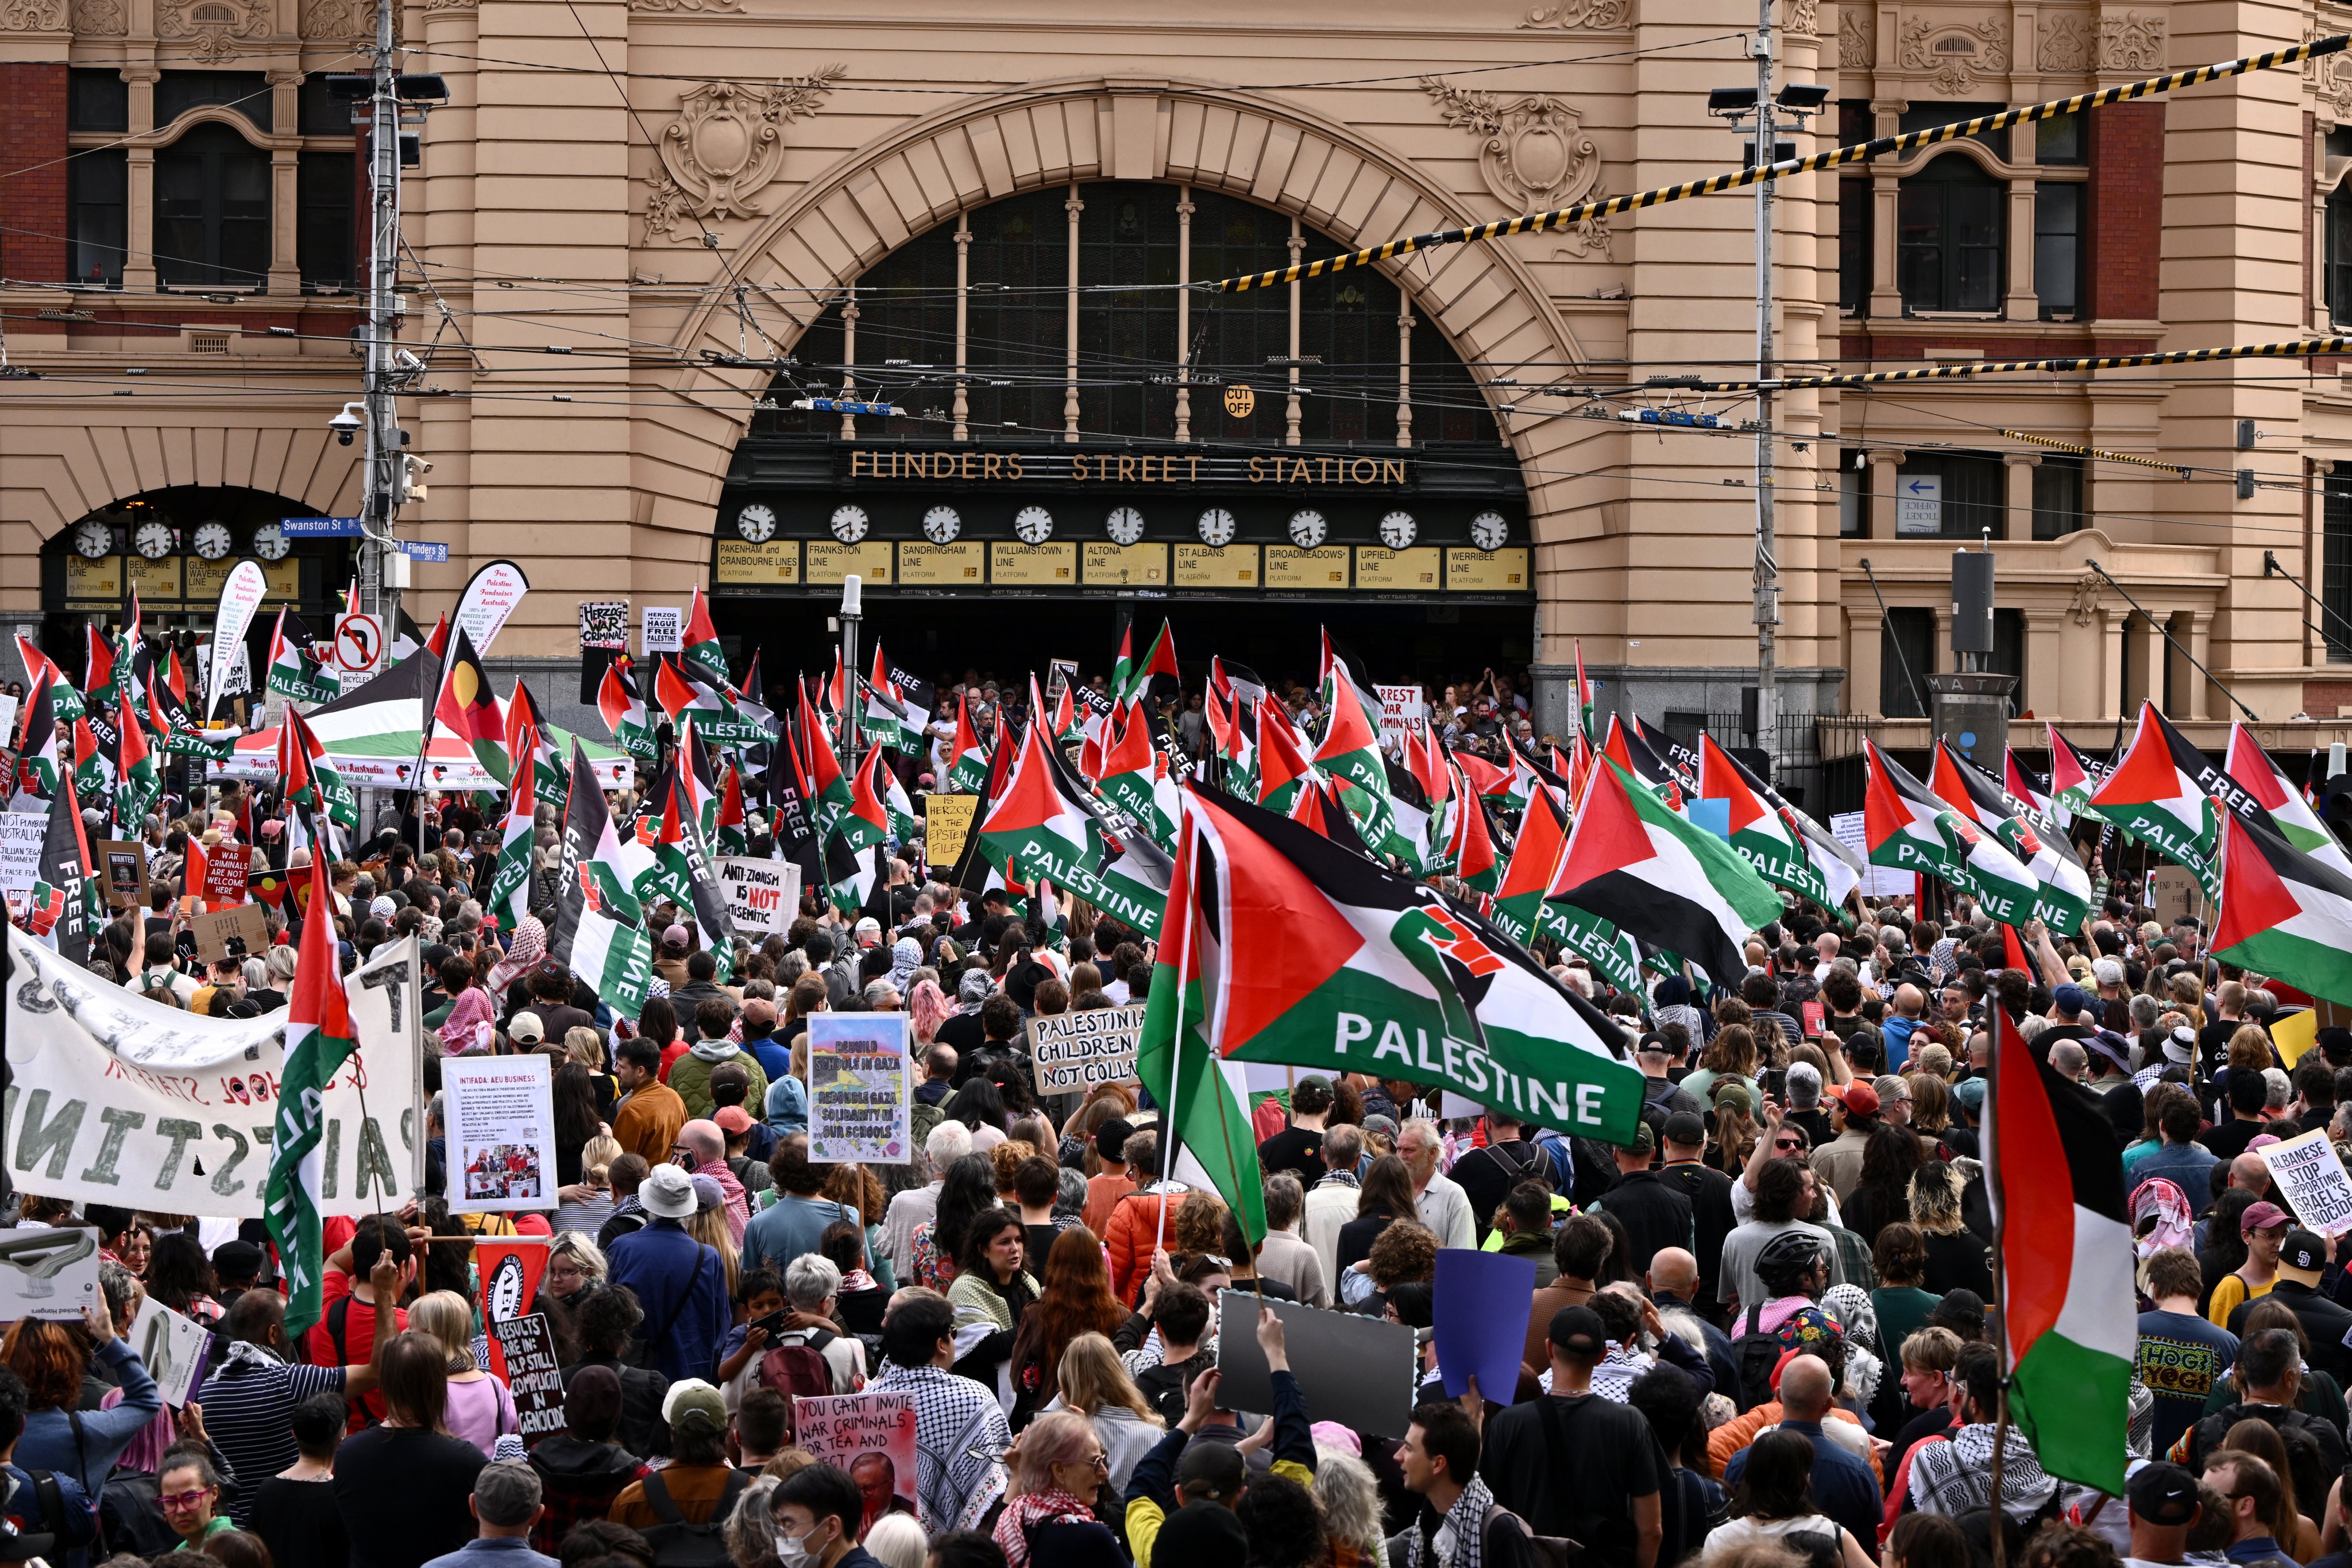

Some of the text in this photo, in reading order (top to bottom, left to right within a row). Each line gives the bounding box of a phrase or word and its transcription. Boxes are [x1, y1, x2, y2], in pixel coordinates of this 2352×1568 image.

[1226, 388, 1249, 399] CUT
[1229, 403, 1251, 414] OFF
[852, 451, 1404, 484] FLINDERS STREET STATION
[1905, 502, 1936, 510] OFFICE
[284, 519, 341, 530] Swanston St
[408, 543, 446, 555] Flinders St
[720, 544, 779, 554] PAKENHAM and
[809, 546, 860, 554] FRANKSTON
[903, 546, 966, 554] SANDRINGHAM
[997, 546, 1061, 555] WILLIAMSTOWN
[1088, 546, 1121, 555] ALTONA
[1179, 549, 1225, 557] ST ALBANS
[1270, 550, 1343, 559] BROADMEADOWS
[1361, 551, 1395, 559] UPFIELD
[720, 557, 797, 566] CRANBOURNE LINES
[809, 558, 828, 566] LINE
[903, 558, 921, 566] LINE
[996, 558, 1014, 566] LINE
[1087, 558, 1106, 566] LINE
[1451, 553, 1494, 561] WERRIBEE
[129, 561, 171, 569] BELGRAVE
[1179, 561, 1197, 569] LINE
[1270, 562, 1288, 570] LINE
[1361, 563, 1379, 571] LINE
[1451, 565, 1469, 573] LINE
[69, 569, 87, 577] LINE
[129, 569, 146, 577] LINE
[495, 569, 508, 577] Free
[583, 605, 622, 622] HERZOG
[588, 617, 621, 632] WAR
[583, 629, 624, 642] CRIMINAL
[890, 667, 921, 692] FREE
[1076, 685, 1112, 712] FREE
[88, 716, 115, 746] FREE
[1156, 733, 1196, 777] FREE
[349, 763, 385, 774] Australia
[2198, 766, 2257, 818] FREE
[783, 787, 810, 839] FREE
[930, 806, 972, 816] HERZOG
[2002, 791, 2052, 835] FREE
[945, 818, 963, 827] THE
[681, 821, 710, 883] FREE
[932, 843, 964, 855] FILES
[2, 855, 39, 864] PARLIAMENT
[111, 854, 135, 864] WANTED
[222, 852, 239, 860] WAR
[209, 859, 248, 870] CRIMINALS
[227, 870, 243, 878] NOT
[721, 862, 779, 886] ANTI-ZIONISM
[207, 876, 245, 887] WELCOME
[1021, 840, 1158, 930] PALESTINE
[2160, 881, 2170, 890] END
[215, 886, 233, 895] HERE
[59, 860, 82, 936] FREE
[736, 885, 781, 910] IS NOT
[1535, 903, 1640, 991] PALESTIN
[836, 1040, 877, 1054] REBUILD
[1037, 1034, 1133, 1062] CHILDREN
[815, 1057, 901, 1071] SCHOOLS IN GAZA
[1334, 1011, 1605, 1126] PALESTINE
[460, 1076, 489, 1084] INTIFADA:
[1043, 1067, 1080, 1087] NOT
[818, 1091, 897, 1104] REDOUBLE GAZA
[822, 1108, 893, 1121] SOLIDARITY IN
[823, 1125, 892, 1138] OUR SCHOOLS
[2270, 1141, 2326, 1169] ALBANESE
[2288, 1162, 2320, 1184] STOP
[2284, 1171, 2342, 1198] SUPPORTING
[2291, 1182, 2350, 1212] ISRAEL'S
[497, 1318, 540, 1341] RESULTS
[203, 1337, 211, 1354] anko
[503, 1338, 537, 1358] ARE IN:
[181, 1341, 200, 1388] Flocked Hangers
[507, 1352, 554, 1377] ALP STILL
[511, 1370, 558, 1397] COMPLICIT
[532, 1391, 546, 1409] IN
[800, 1395, 913, 1419] YOU CANT INVITE
[518, 1405, 569, 1435] GENOCIDE
[800, 1413, 906, 1442] WAR CRIMINALS
[827, 1434, 887, 1450] TEA AND
